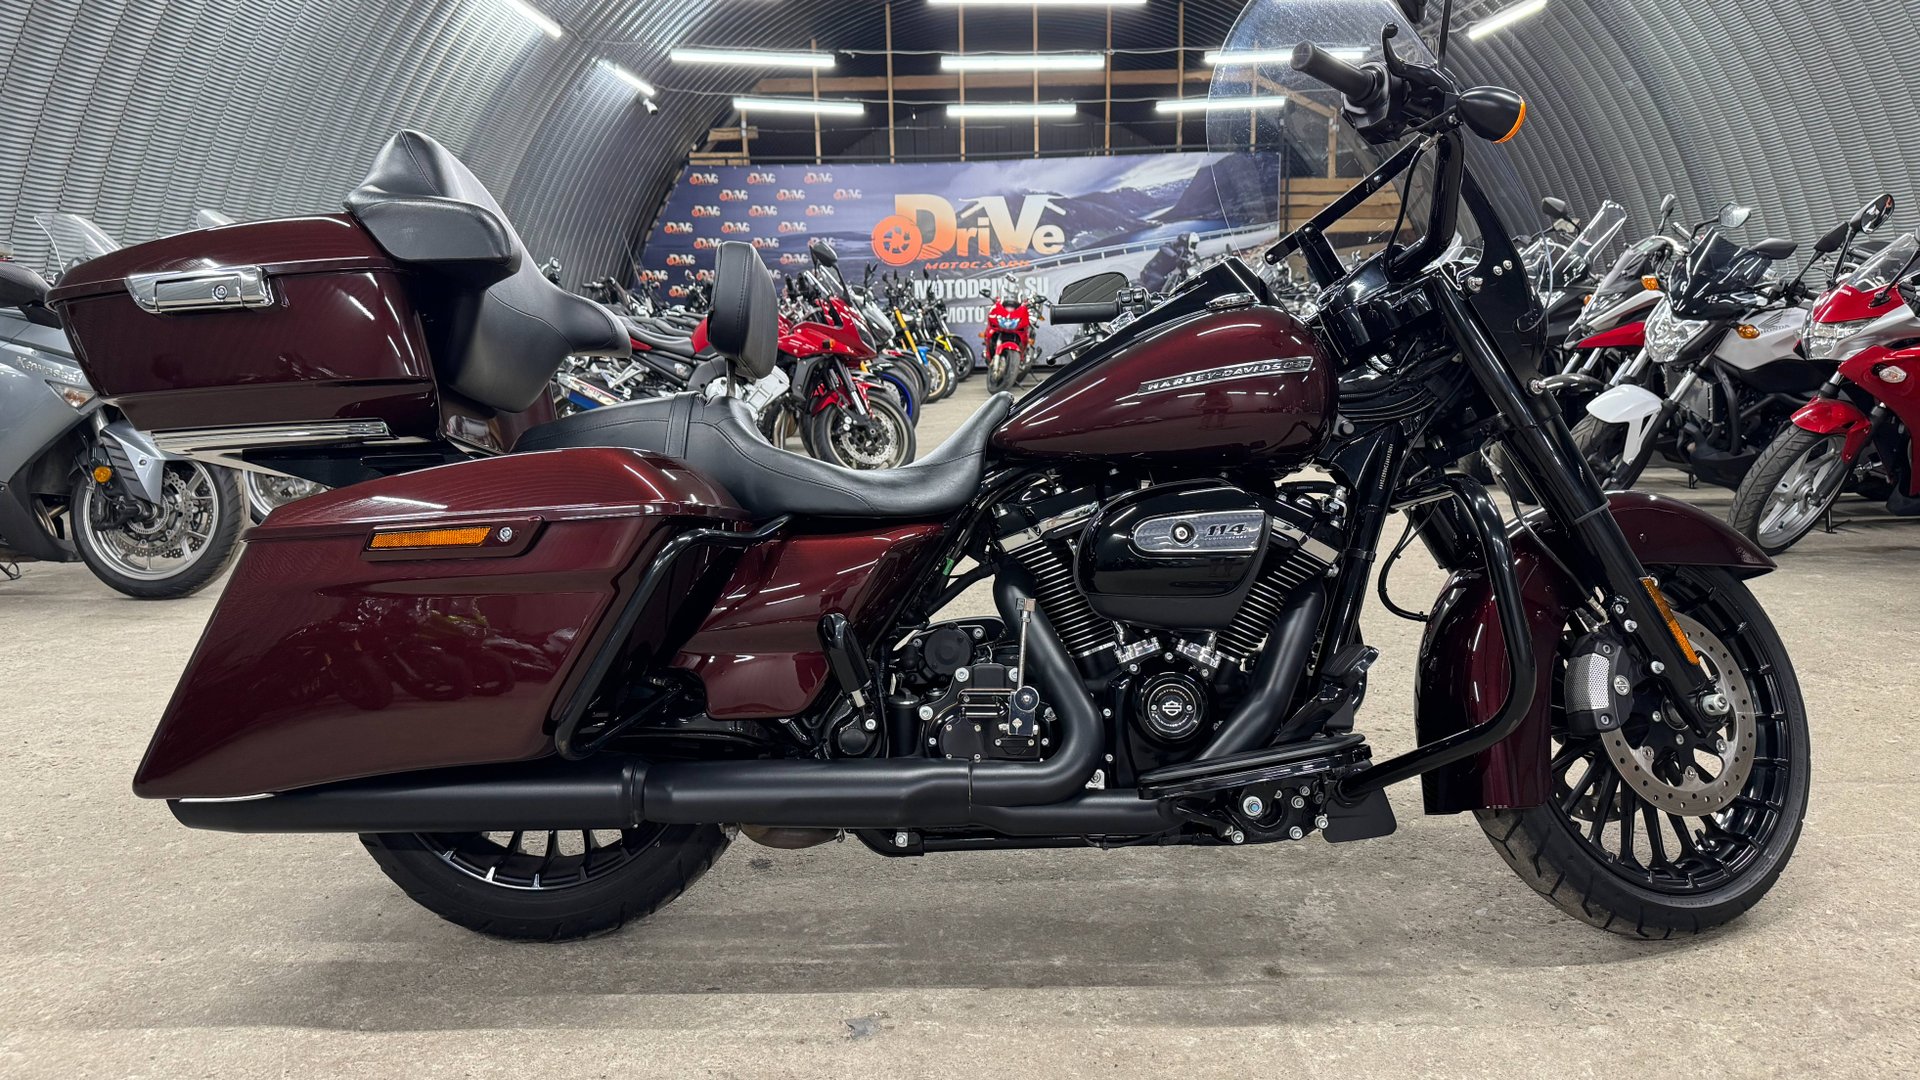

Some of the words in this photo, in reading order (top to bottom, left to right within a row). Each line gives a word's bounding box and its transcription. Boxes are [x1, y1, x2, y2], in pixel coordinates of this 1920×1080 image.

[892, 194, 1066, 257] DriVe
[914, 276, 1049, 300] MOTODRIVESU
[16, 355, 83, 384] Kawasaki
[1147, 359, 1310, 391] HARLEY-DAVIDSON
[1204, 522, 1247, 537] 114
